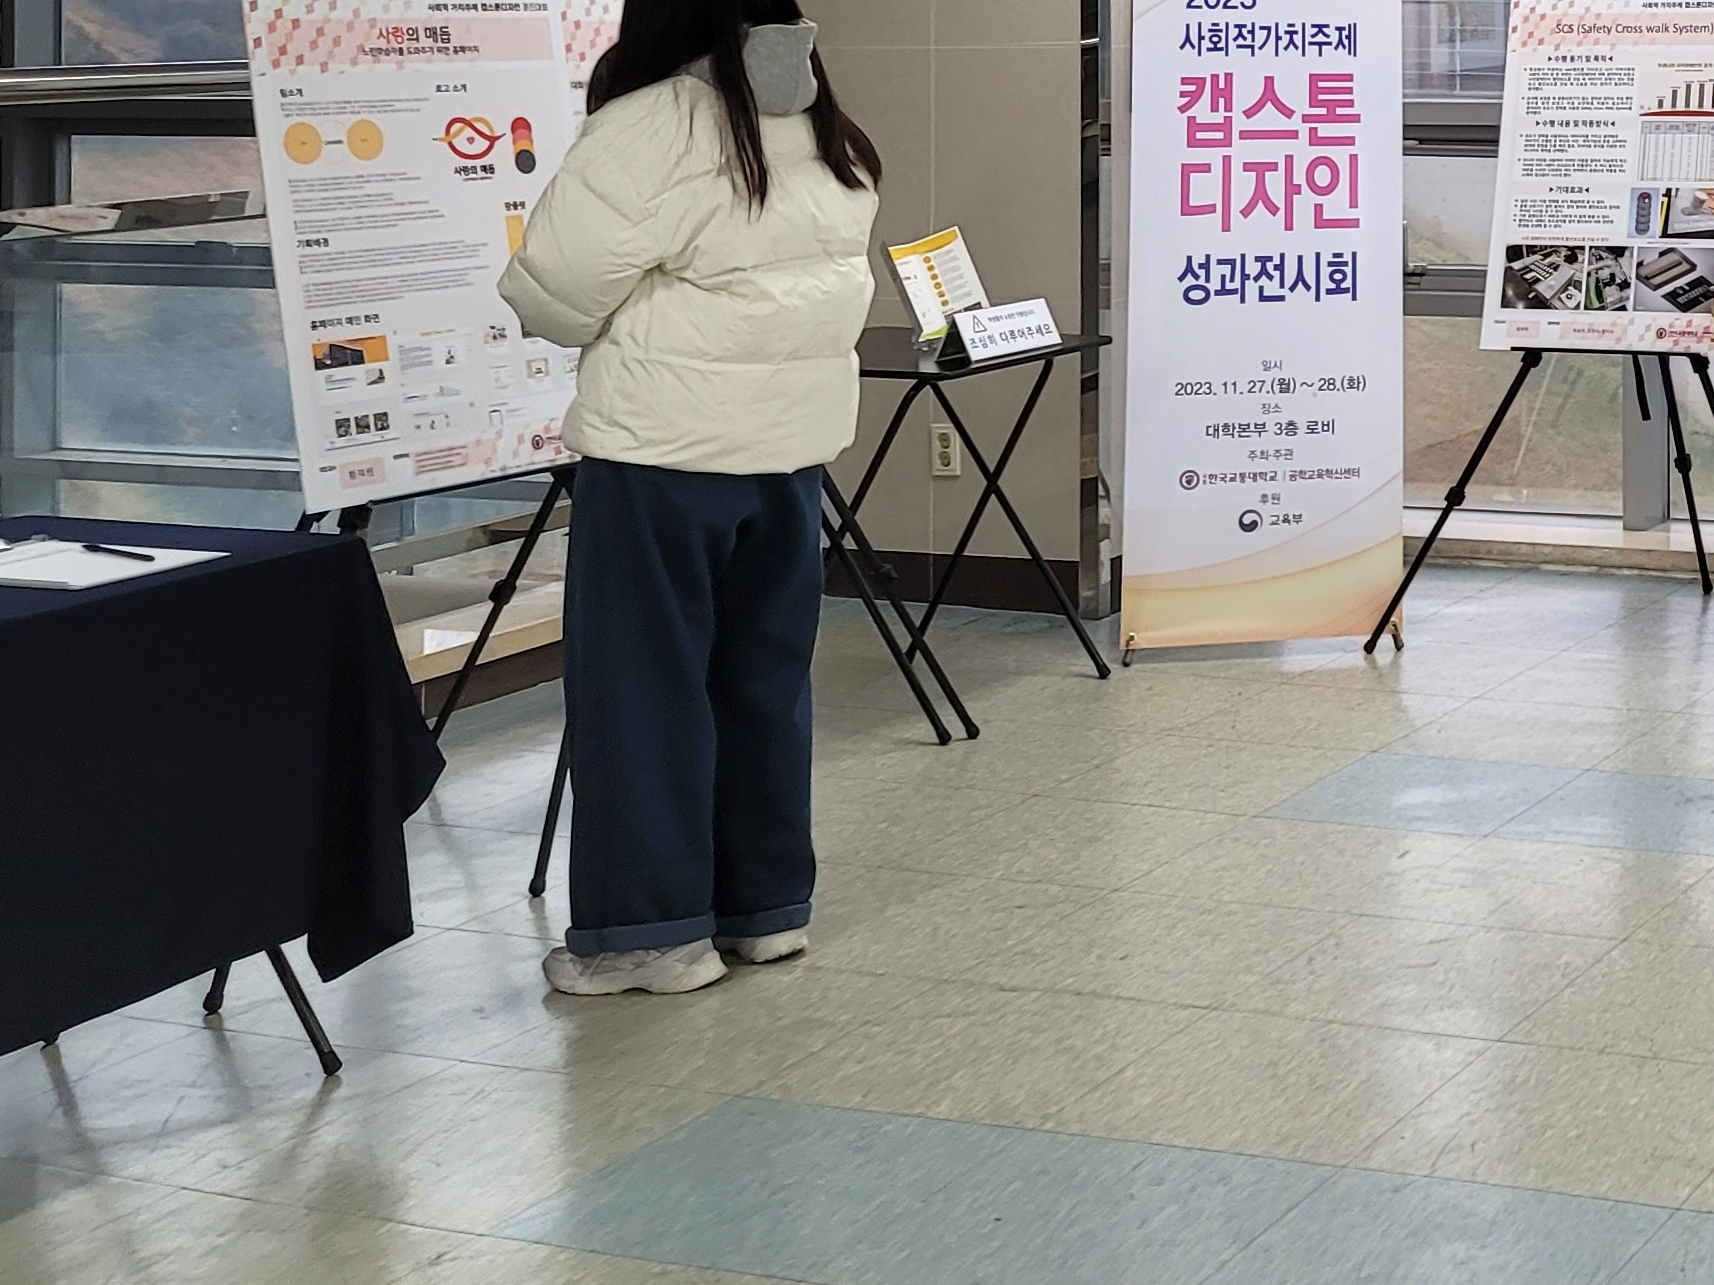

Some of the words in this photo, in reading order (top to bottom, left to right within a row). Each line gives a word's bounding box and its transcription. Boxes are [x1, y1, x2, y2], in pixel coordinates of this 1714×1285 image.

[377, 26, 419, 44] 사랑의
[424, 26, 452, 44] 매듭
[1556, 23, 1574, 34] SCS
[1577, 23, 1612, 35] (Safety
[1615, 23, 1643, 34] Cross
[1646, 22, 1669, 33] walk
[1672, 22, 1714, 35] System)
[1179, 22, 1357, 57] 사회적가치주제
[1177, 72, 1361, 148] 캡스톤
[1180, 154, 1360, 233] 디자인
[1177, 251, 1357, 305] 성과전시회
[1261, 360, 1282, 372] 일시
[1174, 381, 1217, 396] 2023.
[1222, 381, 1244, 395] 11.
[1247, 377, 1296, 395] 27.(월)
[1317, 375, 1366, 393] 28.(화)
[1261, 403, 1282, 415] 장소
[1205, 422, 1268, 439] 대학본부
[1273, 420, 1299, 436] 3층
[1304, 419, 1335, 435] 로비
[1208, 470, 1278, 485] 한국교통대학교
[1288, 467, 1360, 482] 공학교육혁신센터
[1269, 513, 1303, 526] 교육부
